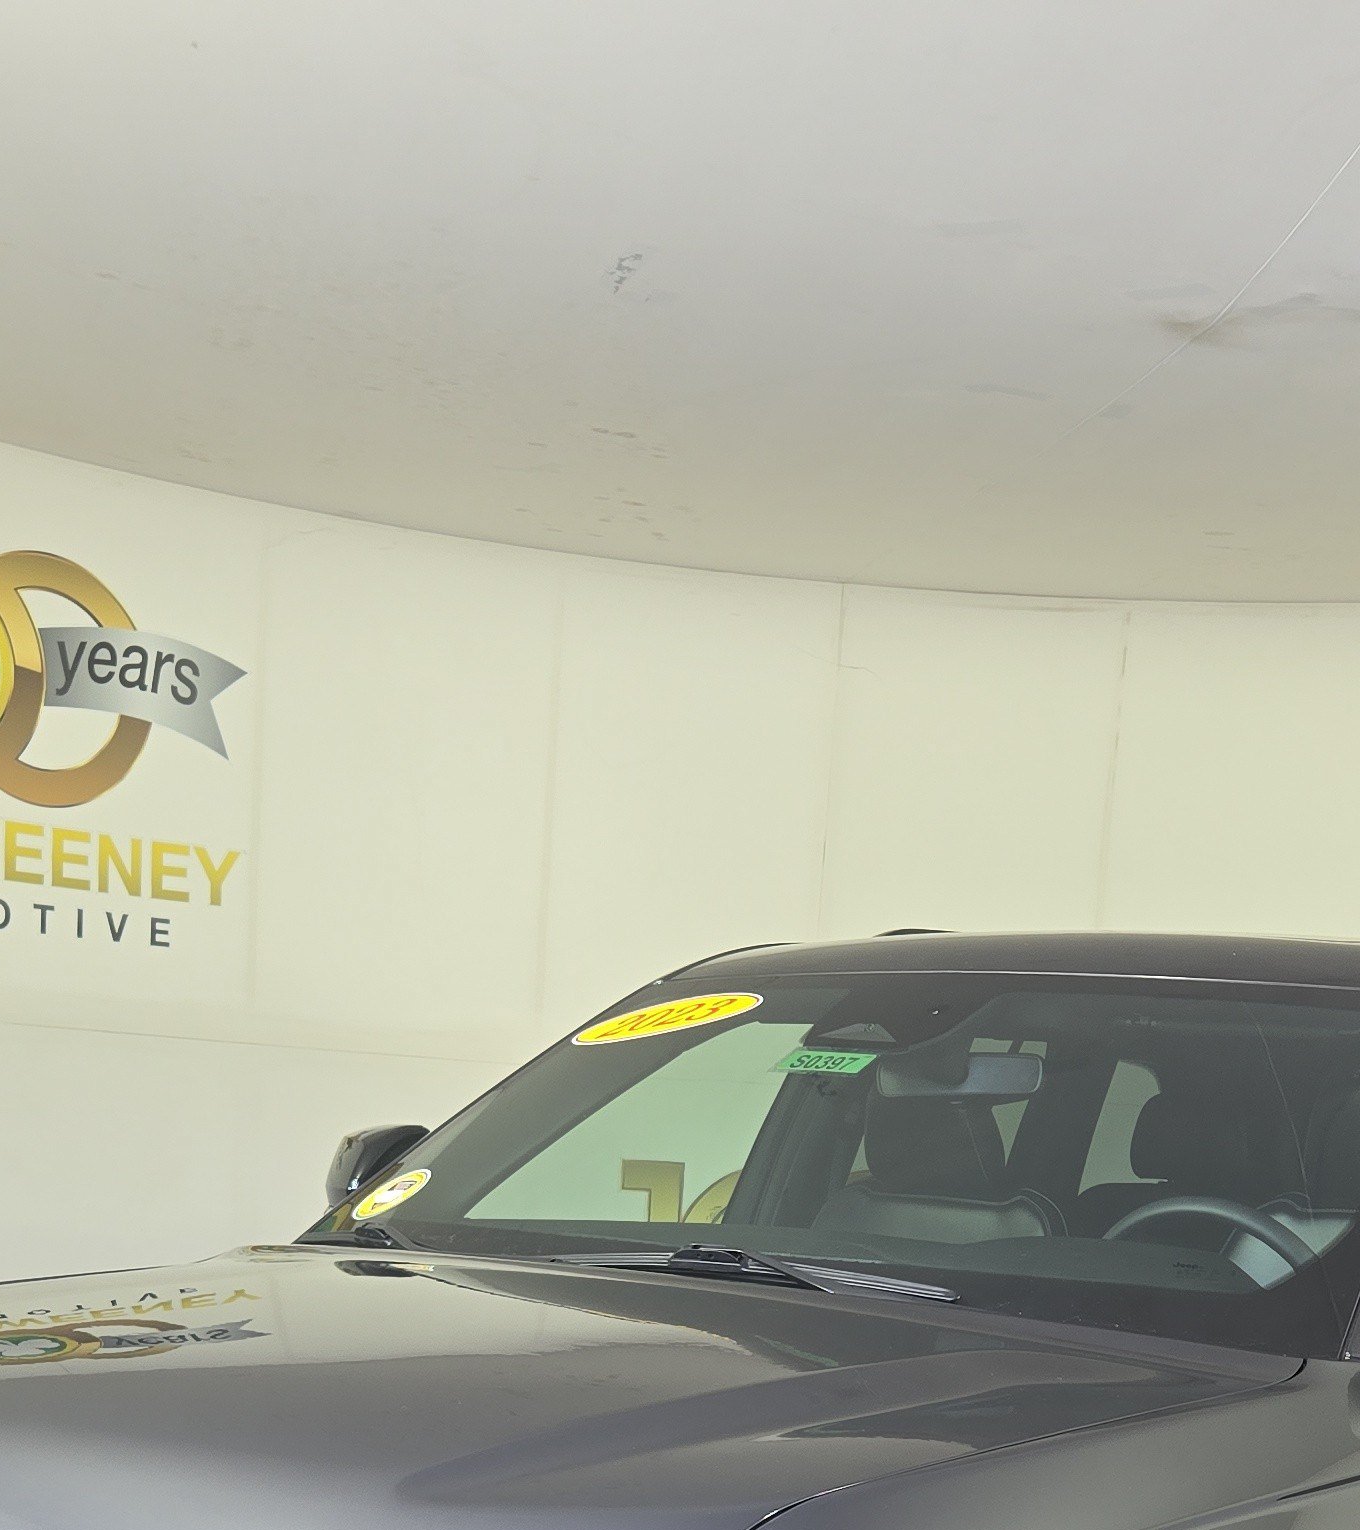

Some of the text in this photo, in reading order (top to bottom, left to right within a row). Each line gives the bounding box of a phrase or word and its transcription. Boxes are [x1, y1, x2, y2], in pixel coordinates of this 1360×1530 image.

[55, 637, 200, 706] years
[595, 998, 738, 1040] 2023
[789, 1054, 860, 1071] S0397
